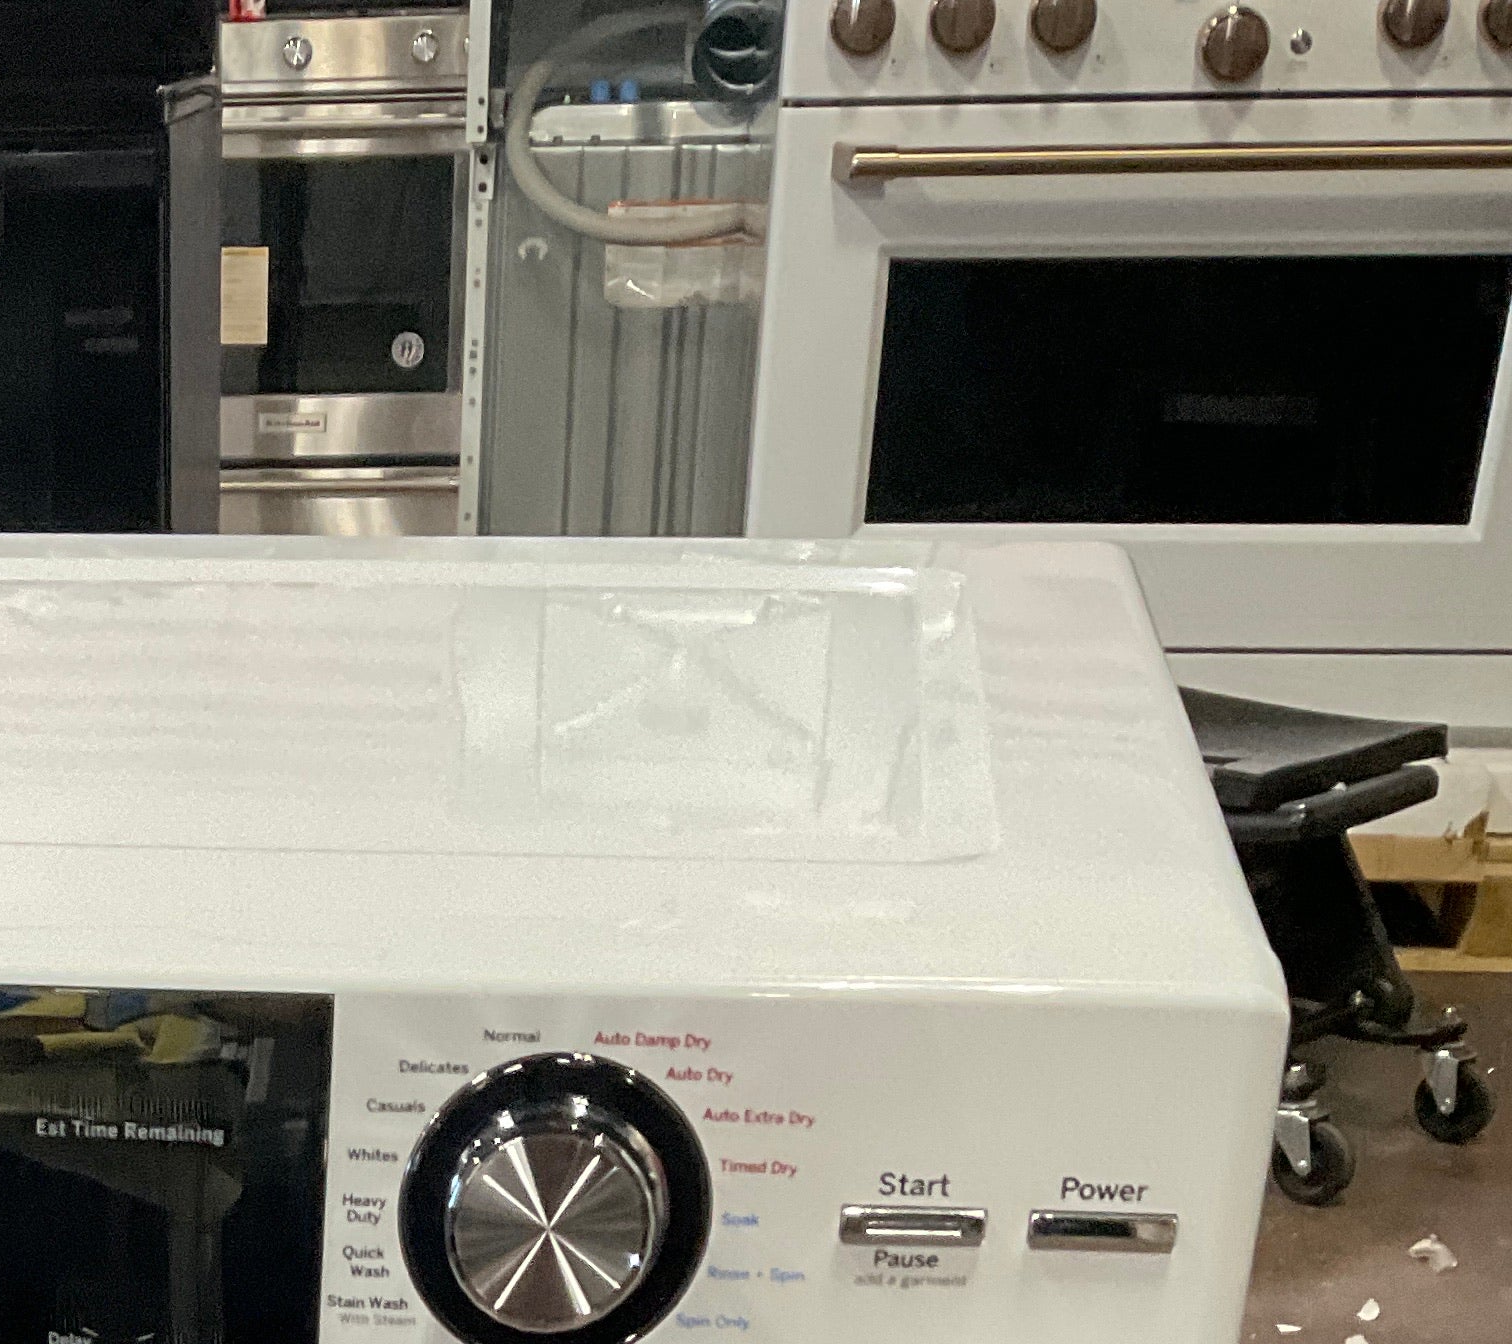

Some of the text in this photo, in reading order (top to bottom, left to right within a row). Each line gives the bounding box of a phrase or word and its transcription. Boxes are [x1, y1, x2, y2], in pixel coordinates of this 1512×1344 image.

[484, 1029, 541, 1043] Normal
[594, 1031, 712, 1051] Auto Damp Dry
[399, 1060, 470, 1074] Delicates
[666, 1066, 734, 1085] Auto Dry
[366, 1098, 426, 1113] Casuals
[703, 1107, 817, 1128] Auto Extra Dry
[72, 1119, 118, 1140] Time
[124, 1121, 225, 1147] Remaining
[348, 1148, 399, 1162] Whites
[719, 1158, 798, 1177] Timed Dry
[878, 1172, 951, 1197] Start
[1060, 1176, 1149, 1202] Power
[342, 1193, 386, 1210] Heavy
[347, 1209, 381, 1225] Duty
[342, 1245, 384, 1260] Quick
[873, 1249, 940, 1268] Pause
[350, 1265, 390, 1278] Wash
[327, 1294, 409, 1310] Stain Wash
